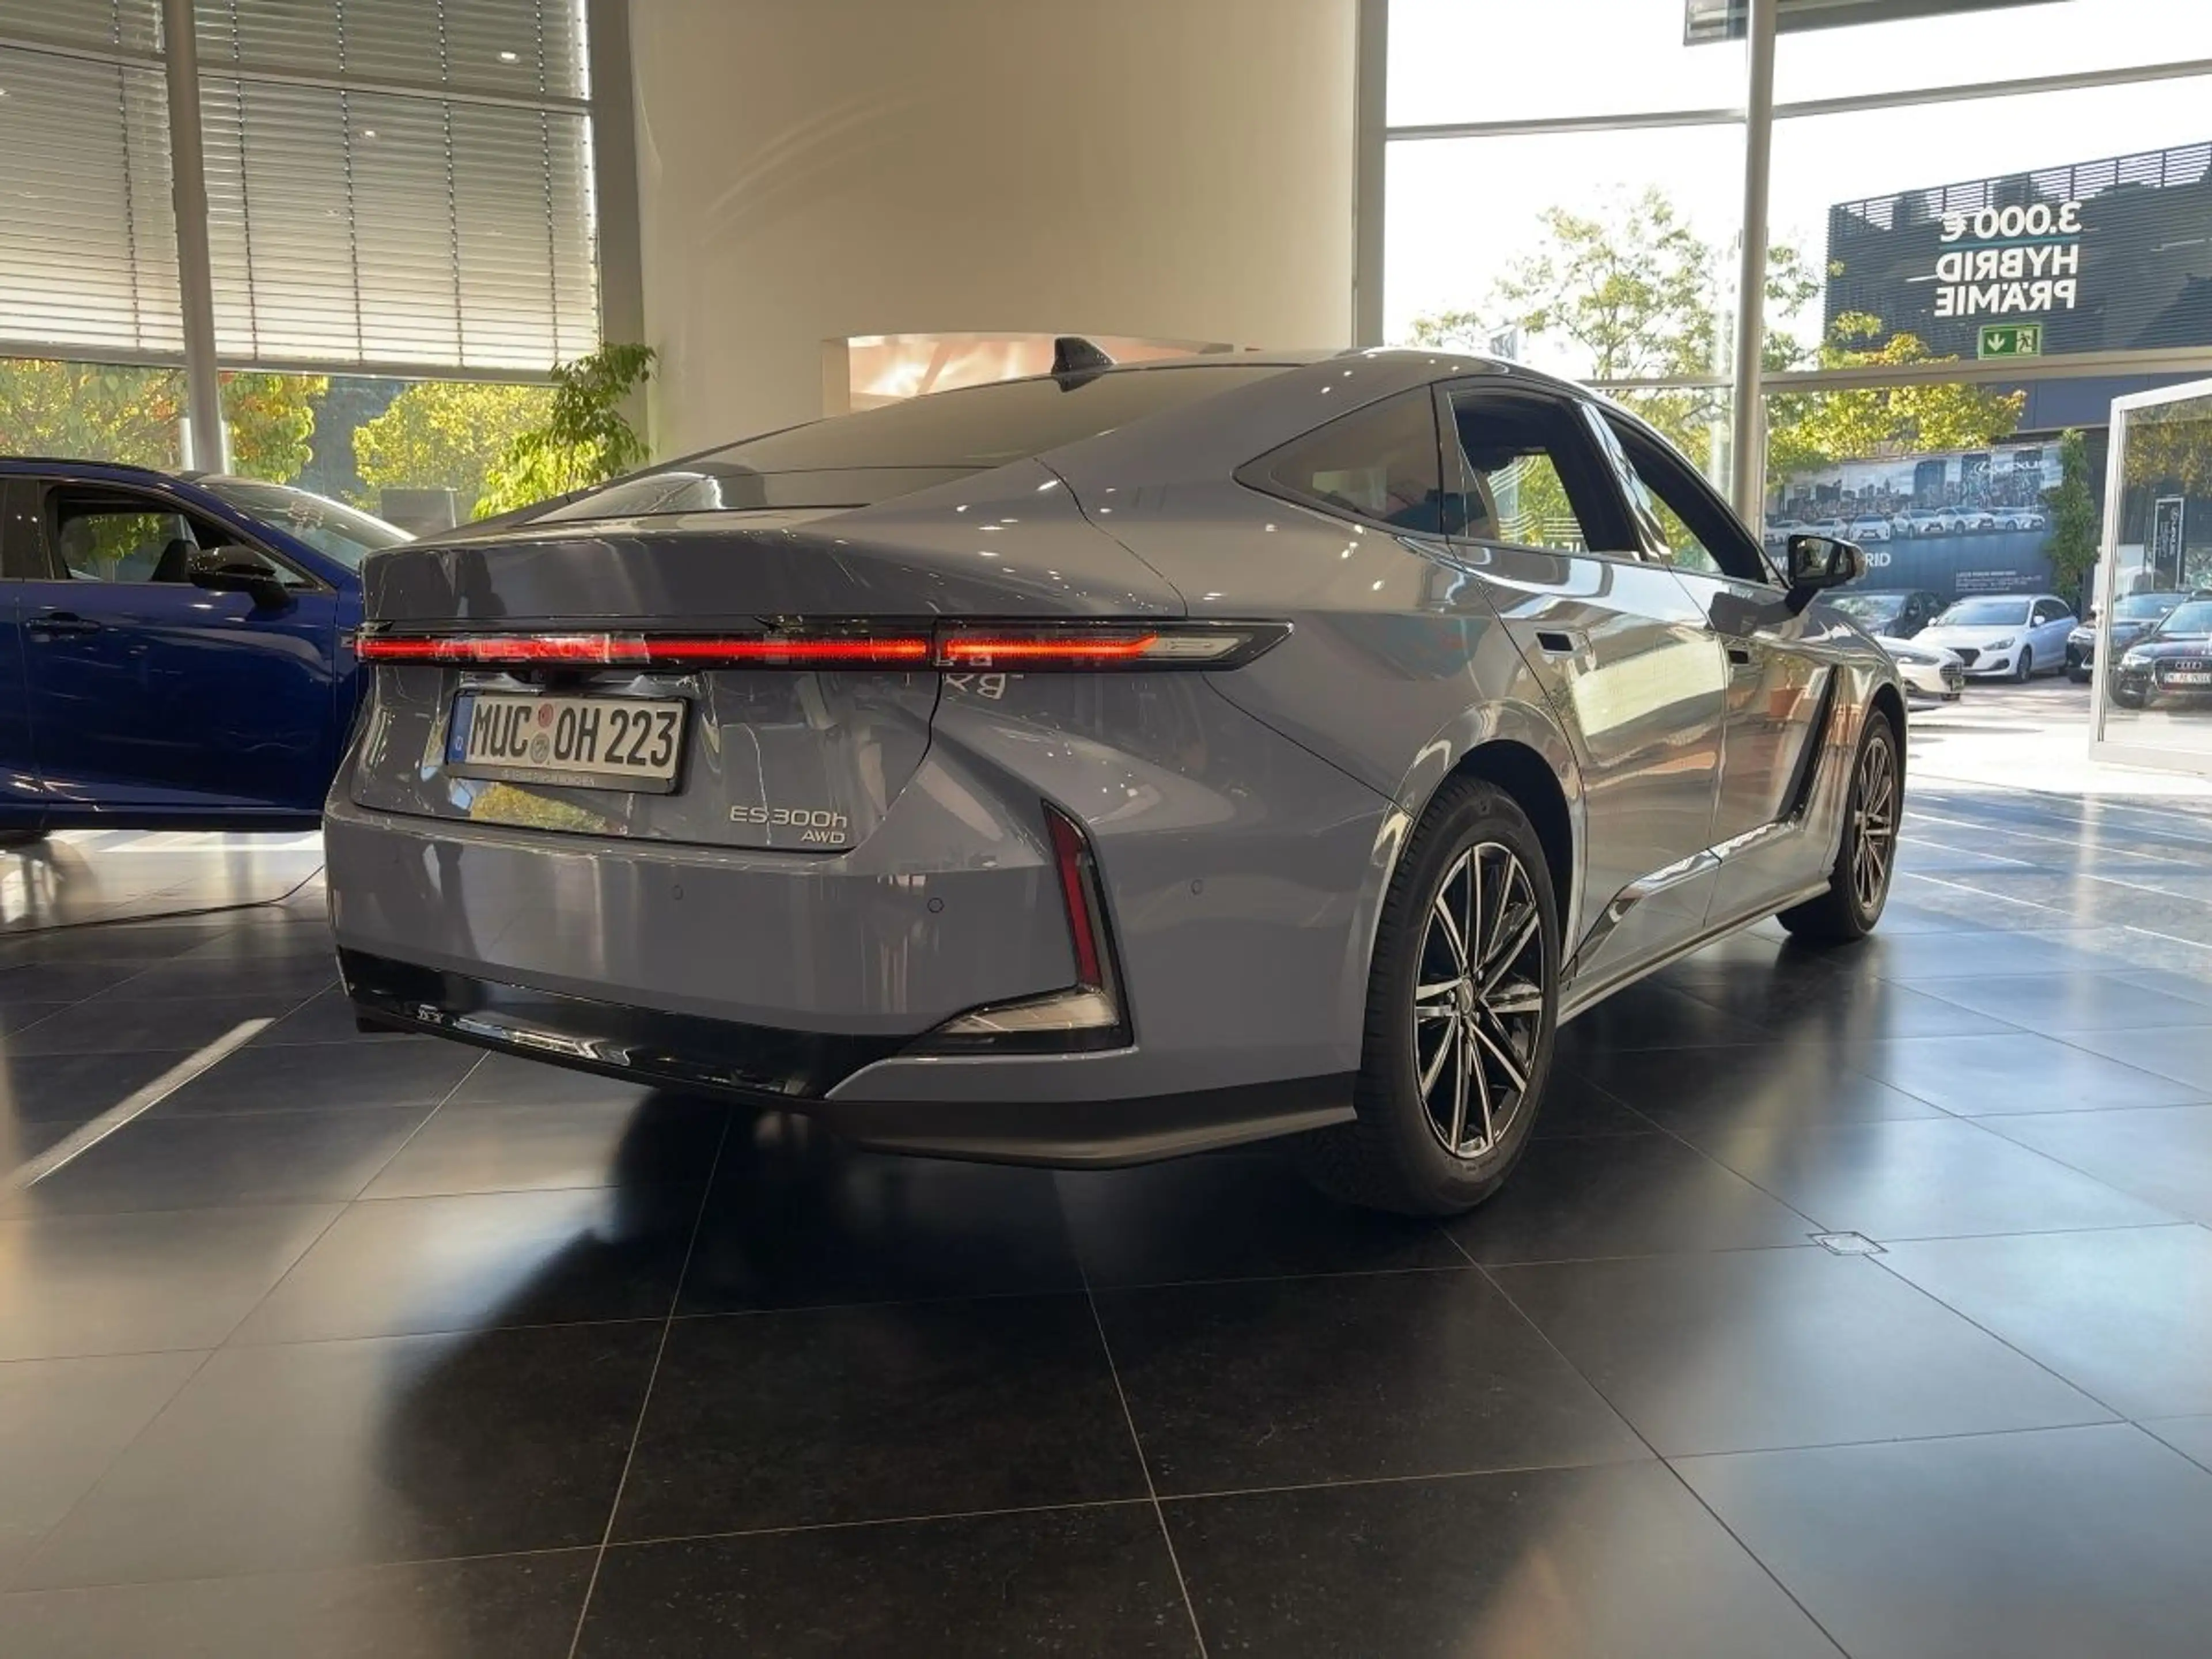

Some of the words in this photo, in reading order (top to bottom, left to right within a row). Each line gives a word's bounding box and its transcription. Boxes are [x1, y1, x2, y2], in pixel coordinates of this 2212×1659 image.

[469, 703, 532, 757] MUC
[554, 707, 601, 763] OH
[604, 709, 678, 768] 223
[800, 829, 846, 844] AWD
